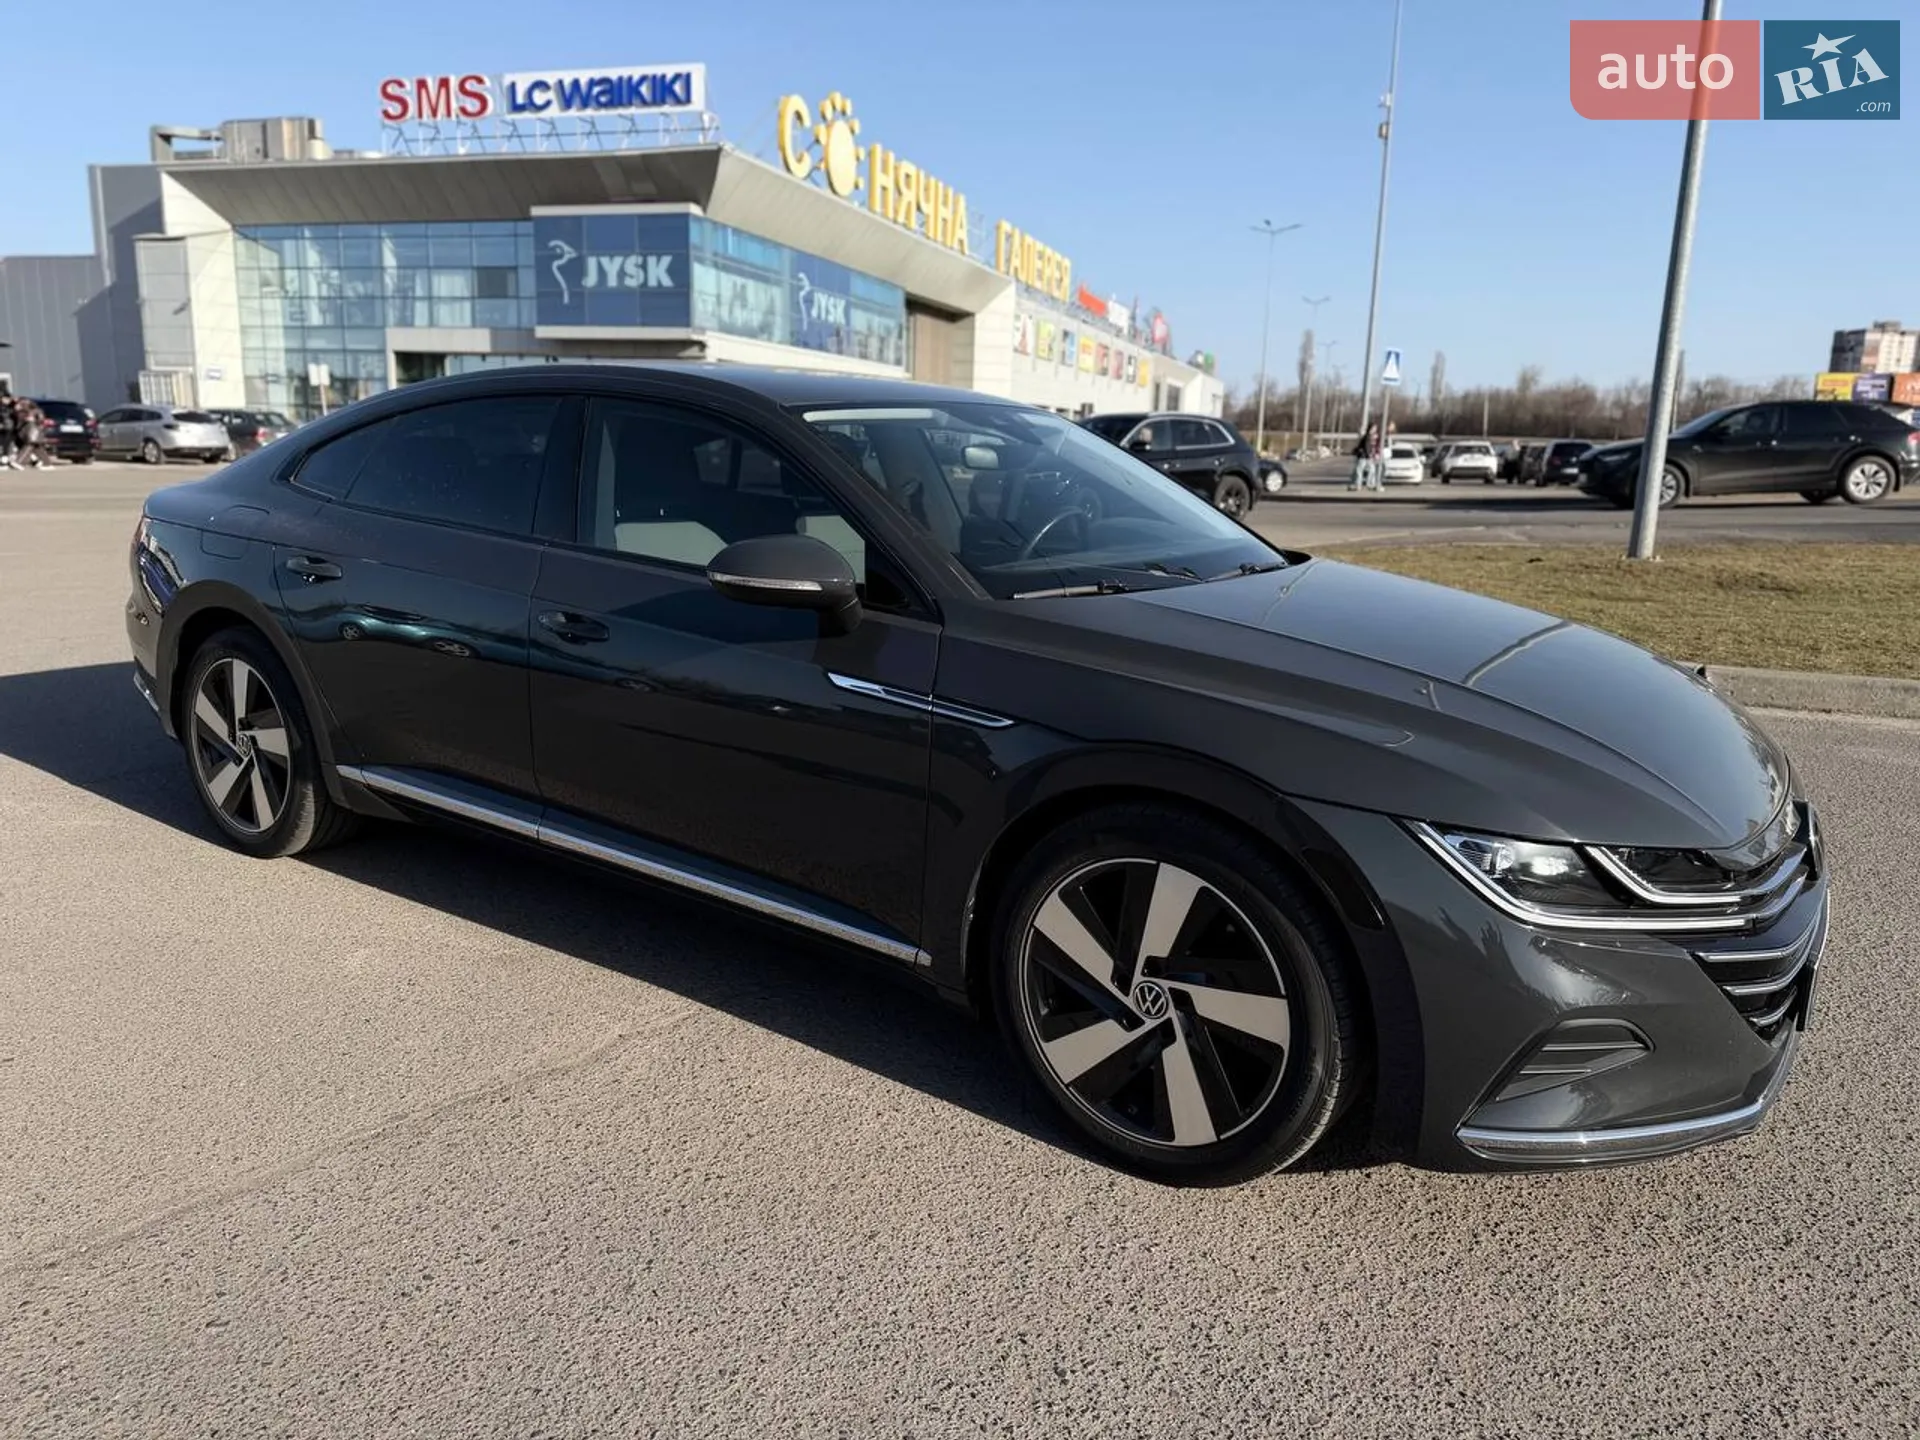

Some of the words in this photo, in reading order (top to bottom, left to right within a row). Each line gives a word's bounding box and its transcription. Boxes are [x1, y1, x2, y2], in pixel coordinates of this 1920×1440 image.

[380, 75, 489, 121] SMS
[507, 80, 552, 113] LC
[581, 255, 674, 288] JYSK
[996, 218, 1071, 302] ГАЛЕРЕЯ
[811, 291, 846, 325] JYSK
